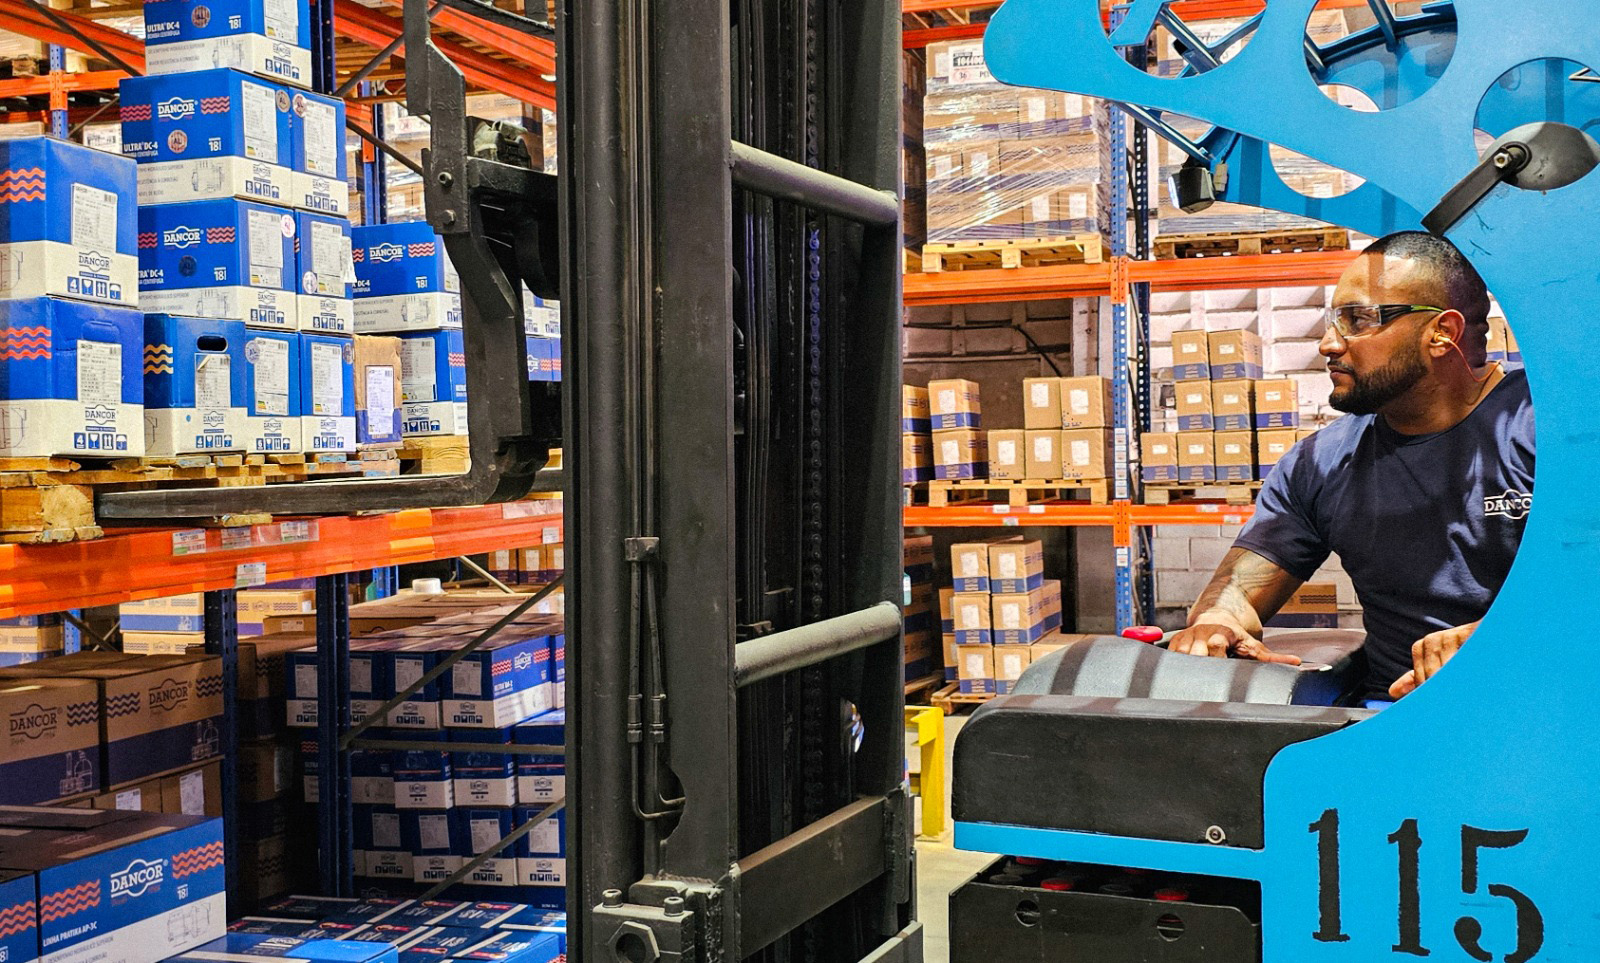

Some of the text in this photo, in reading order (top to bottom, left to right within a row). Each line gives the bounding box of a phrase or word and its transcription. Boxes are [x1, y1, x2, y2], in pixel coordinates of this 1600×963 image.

[157, 102, 195, 117] DANCOR
[164, 231, 201, 244] DANCOR
[369, 247, 404, 257] DANCOR
[79, 255, 110, 268] DANCOR
[85, 410, 116, 419] DANCOR
[1484, 497, 1532, 512] DANCO
[149, 686, 189, 705] DANCOR
[9, 712, 58, 731] DANCOR
[110, 864, 163, 893] DANCOR
[1308, 808, 1544, 963] 115
[43, 921, 98, 947] LINHA PRATIKA AP-3C
